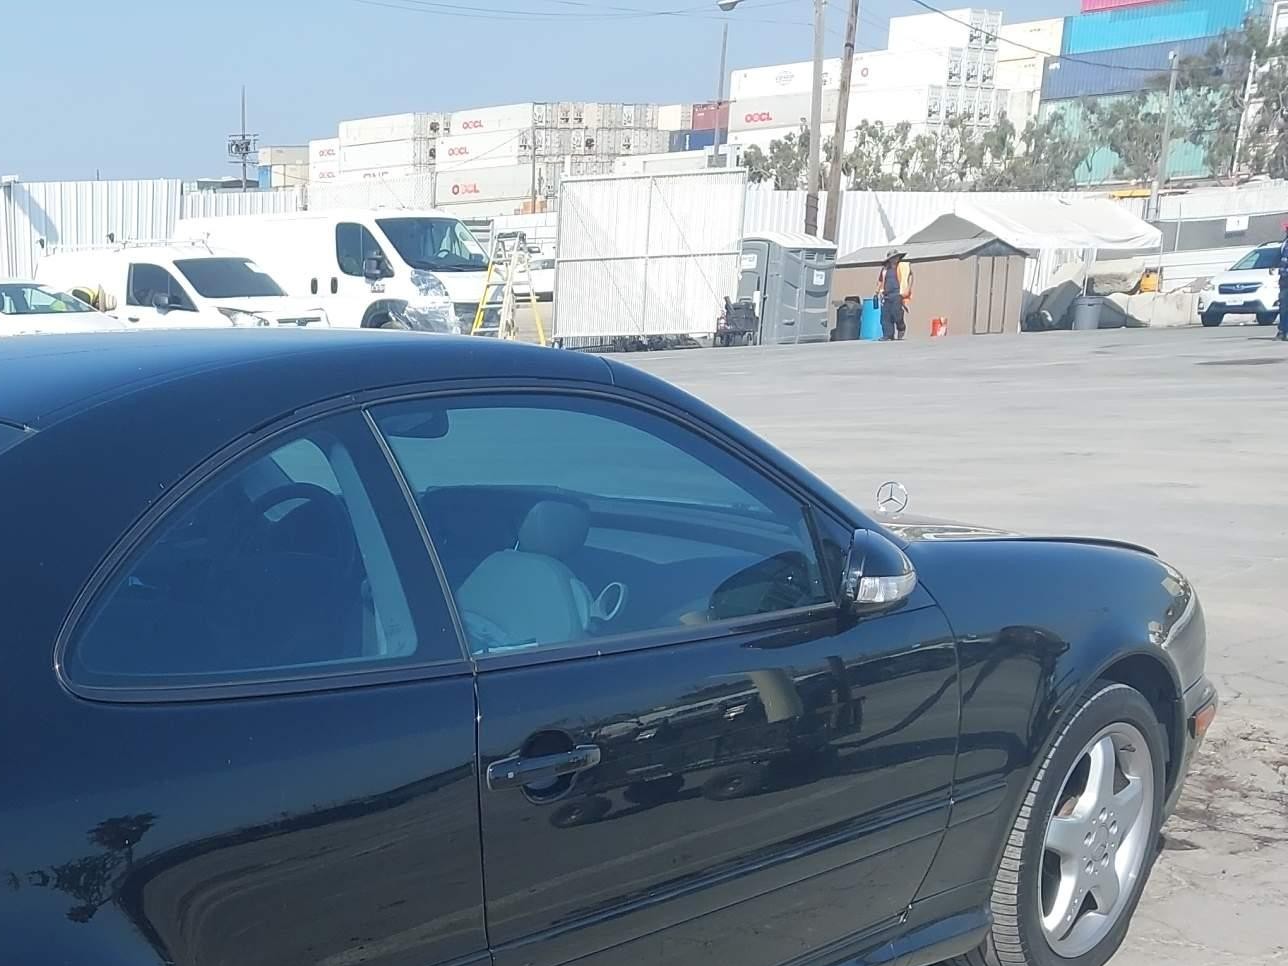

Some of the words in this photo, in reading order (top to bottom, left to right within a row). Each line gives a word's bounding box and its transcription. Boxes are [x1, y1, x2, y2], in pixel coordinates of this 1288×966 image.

[745, 112, 773, 123] OOCL
[462, 120, 484, 130] OOCL
[448, 146, 470, 156] OOCL
